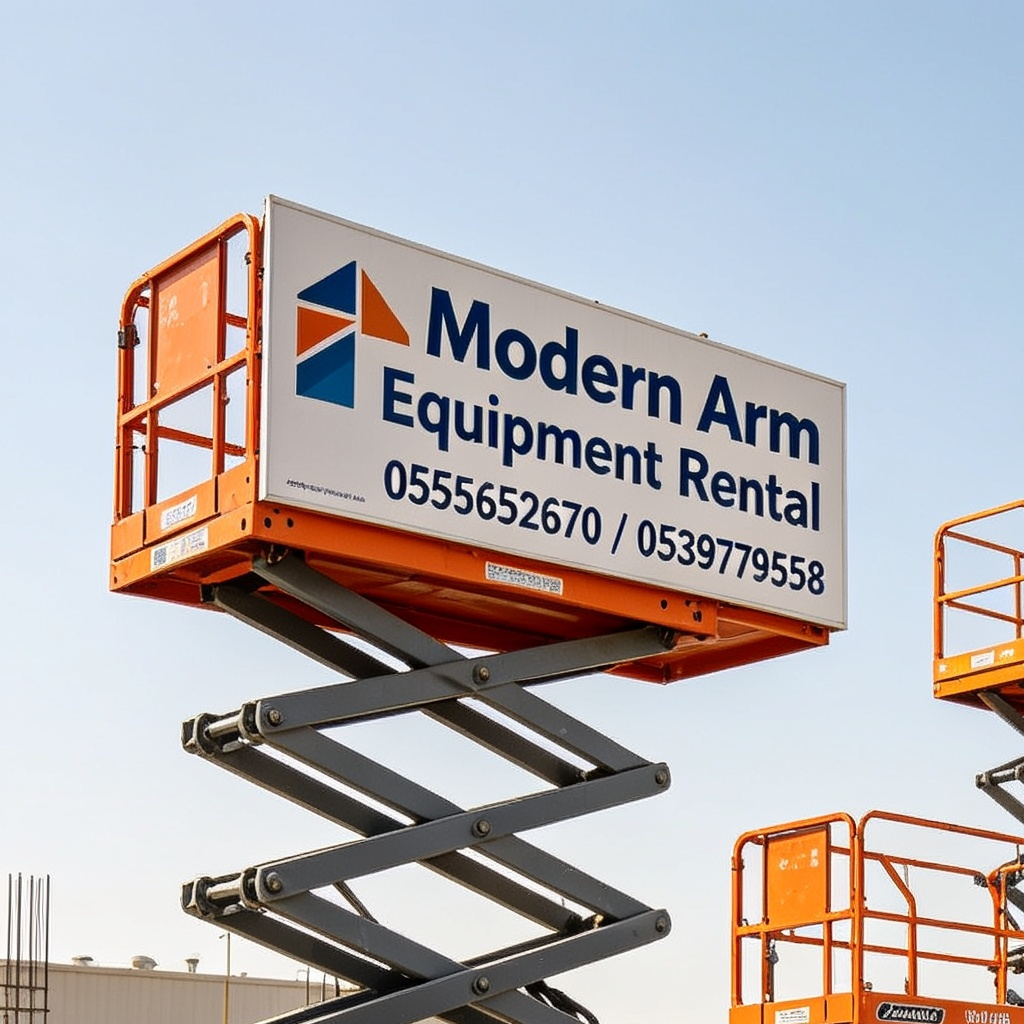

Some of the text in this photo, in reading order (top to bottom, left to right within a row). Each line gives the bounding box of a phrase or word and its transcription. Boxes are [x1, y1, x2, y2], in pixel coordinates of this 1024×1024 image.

[382, 365, 820, 532] Equipment Rental
[426, 286, 820, 466] Modern Arm
[383, 459, 602, 546] 0555652670
[610, 512, 628, 555] /
[637, 519, 825, 596] 0539779558
